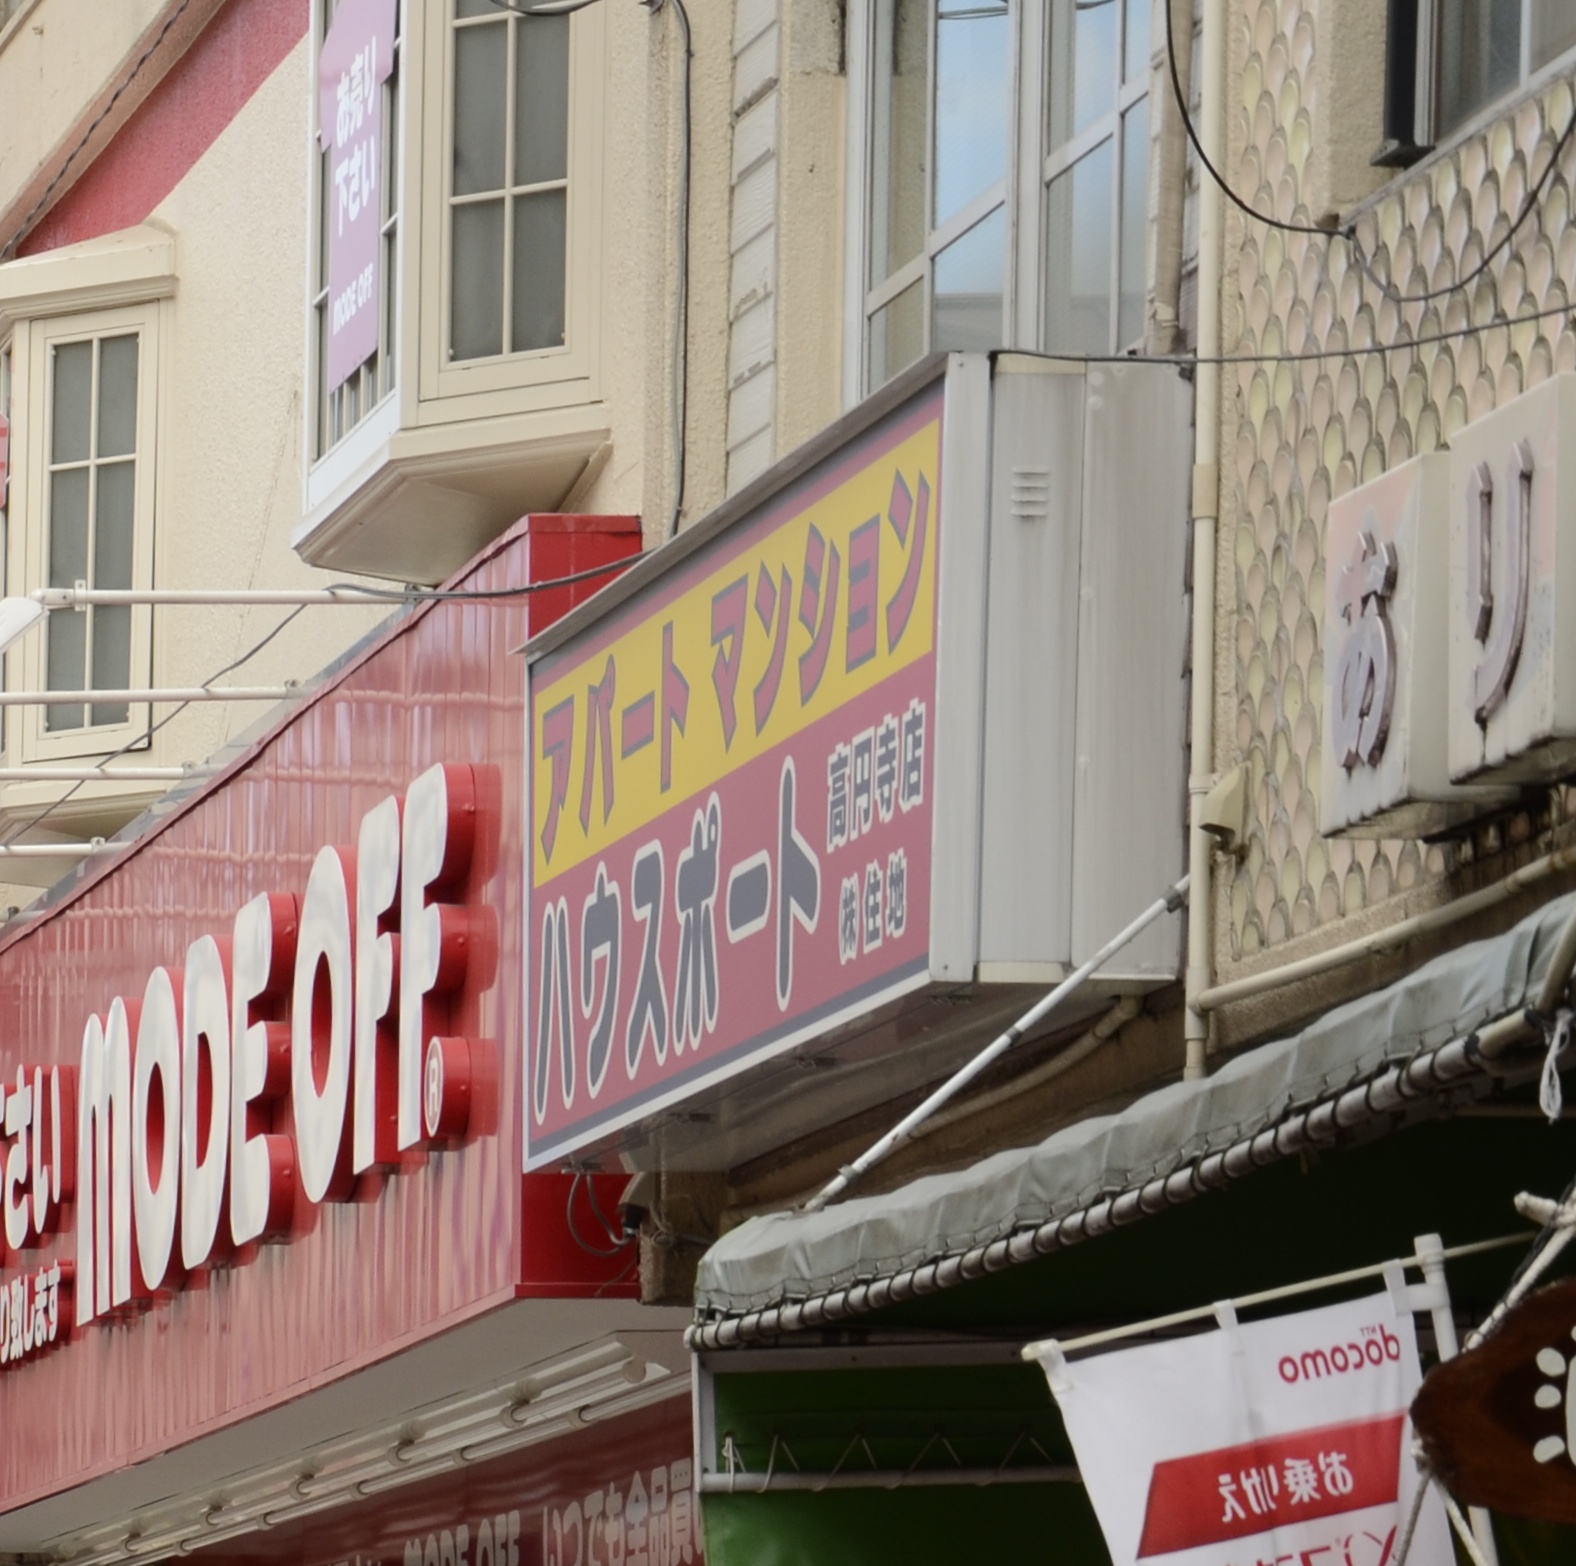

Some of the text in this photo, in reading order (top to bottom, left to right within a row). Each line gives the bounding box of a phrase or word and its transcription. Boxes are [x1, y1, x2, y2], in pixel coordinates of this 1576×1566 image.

[335, 137, 376, 237] 下さい
[541, 468, 932, 865] アパート マンション
[827, 699, 927, 853] 高円寺店
[76, 763, 448, 1326] MODE OFF
[533, 756, 822, 1125] ハウスポート
